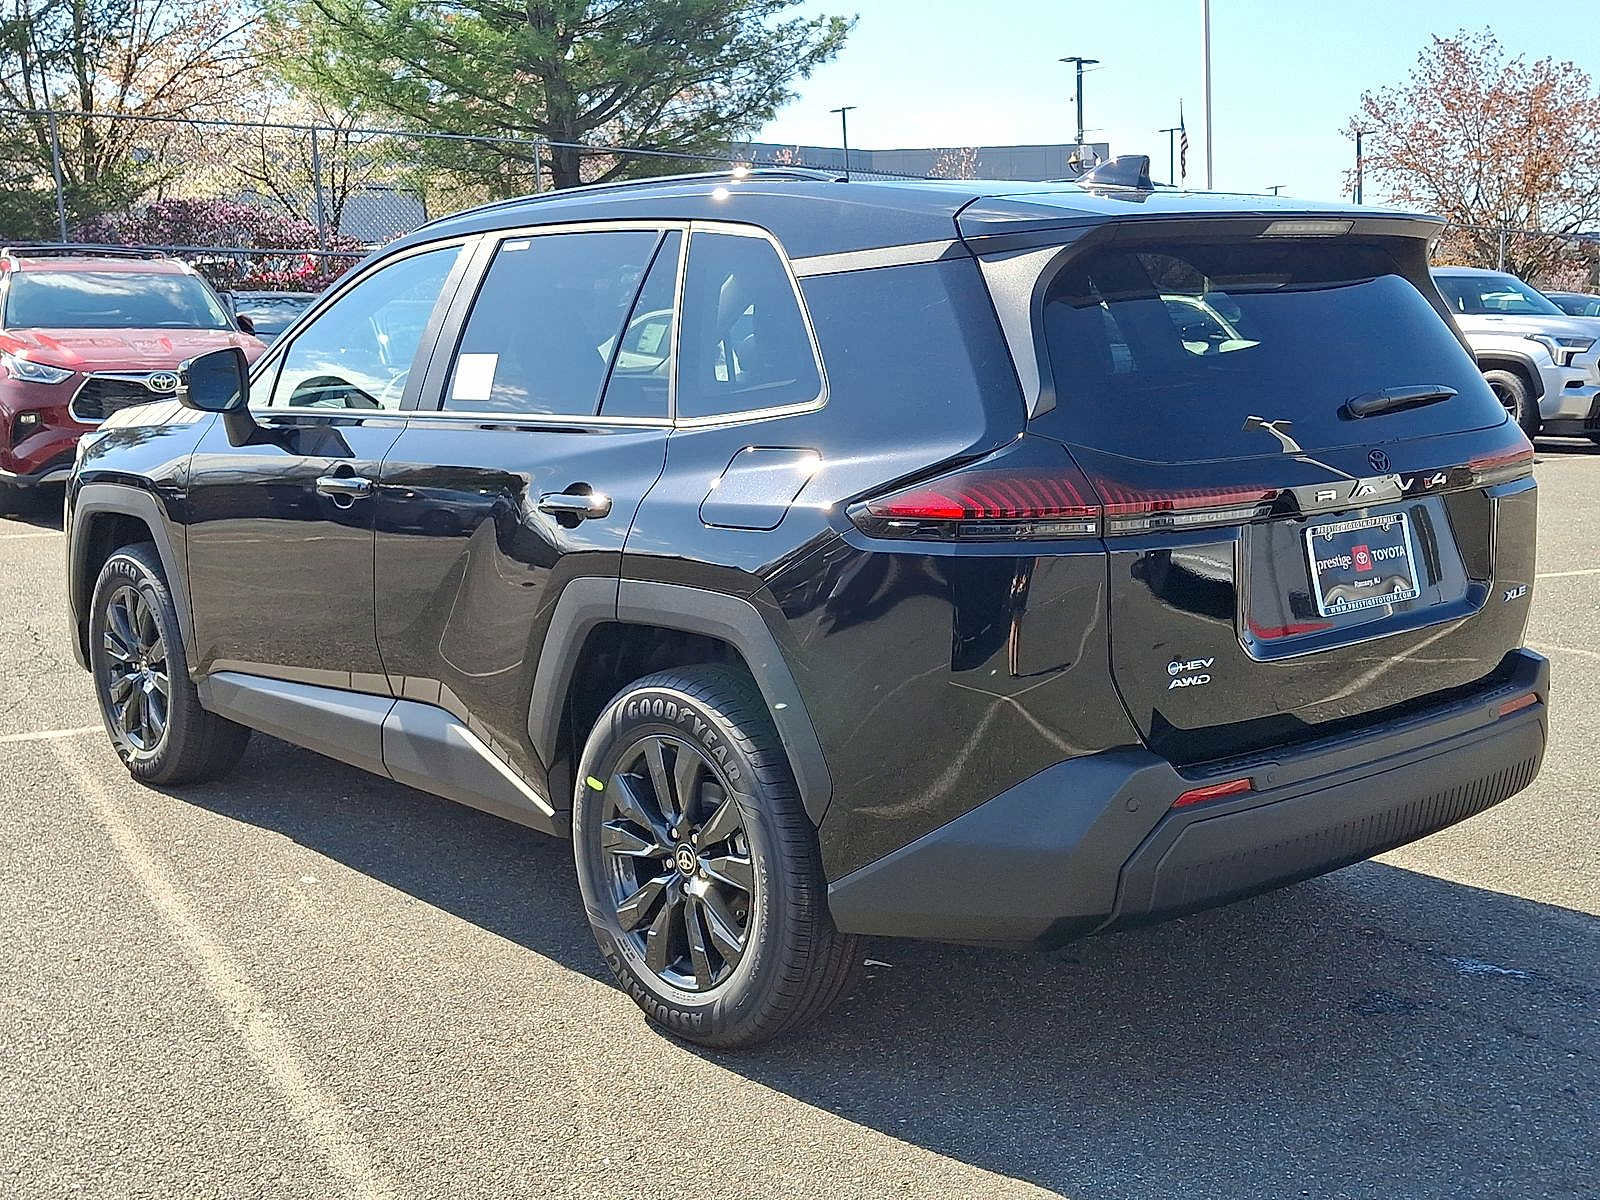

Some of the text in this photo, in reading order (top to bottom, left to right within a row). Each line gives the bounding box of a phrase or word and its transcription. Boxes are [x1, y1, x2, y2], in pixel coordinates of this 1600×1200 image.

[1315, 472, 1447, 503] RAV4
[1316, 545, 1406, 576] prestige TOYOTA
[1504, 585, 1528, 602] XLE
[1168, 674, 1211, 690] AWD
[627, 698, 742, 782] GOODYEAR
[600, 940, 703, 1024] ASSURANCE
